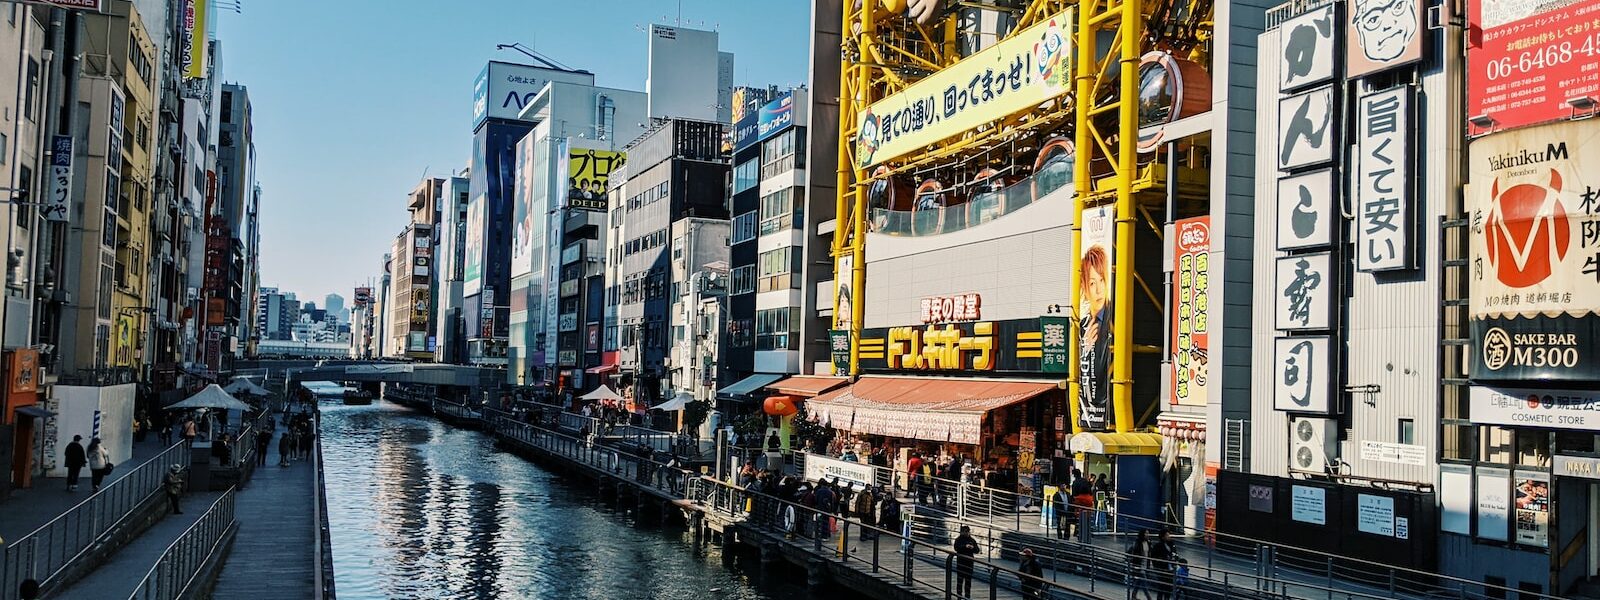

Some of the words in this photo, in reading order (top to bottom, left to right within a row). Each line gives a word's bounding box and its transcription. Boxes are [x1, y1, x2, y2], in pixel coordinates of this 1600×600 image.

[1488, 149, 1545, 172] Yakiniku
[1364, 95, 1401, 263] 旨くて安い
[571, 199, 606, 208] DEEP
[831, 334, 849, 351] 薬
[1043, 323, 1065, 347] 薬
[1513, 333, 1546, 346] SAKE
[1548, 333, 1577, 346] BAR
[1512, 346, 1579, 368] M300
[1511, 412, 1553, 424] COSMETIC
[1558, 415, 1585, 425] STORE
